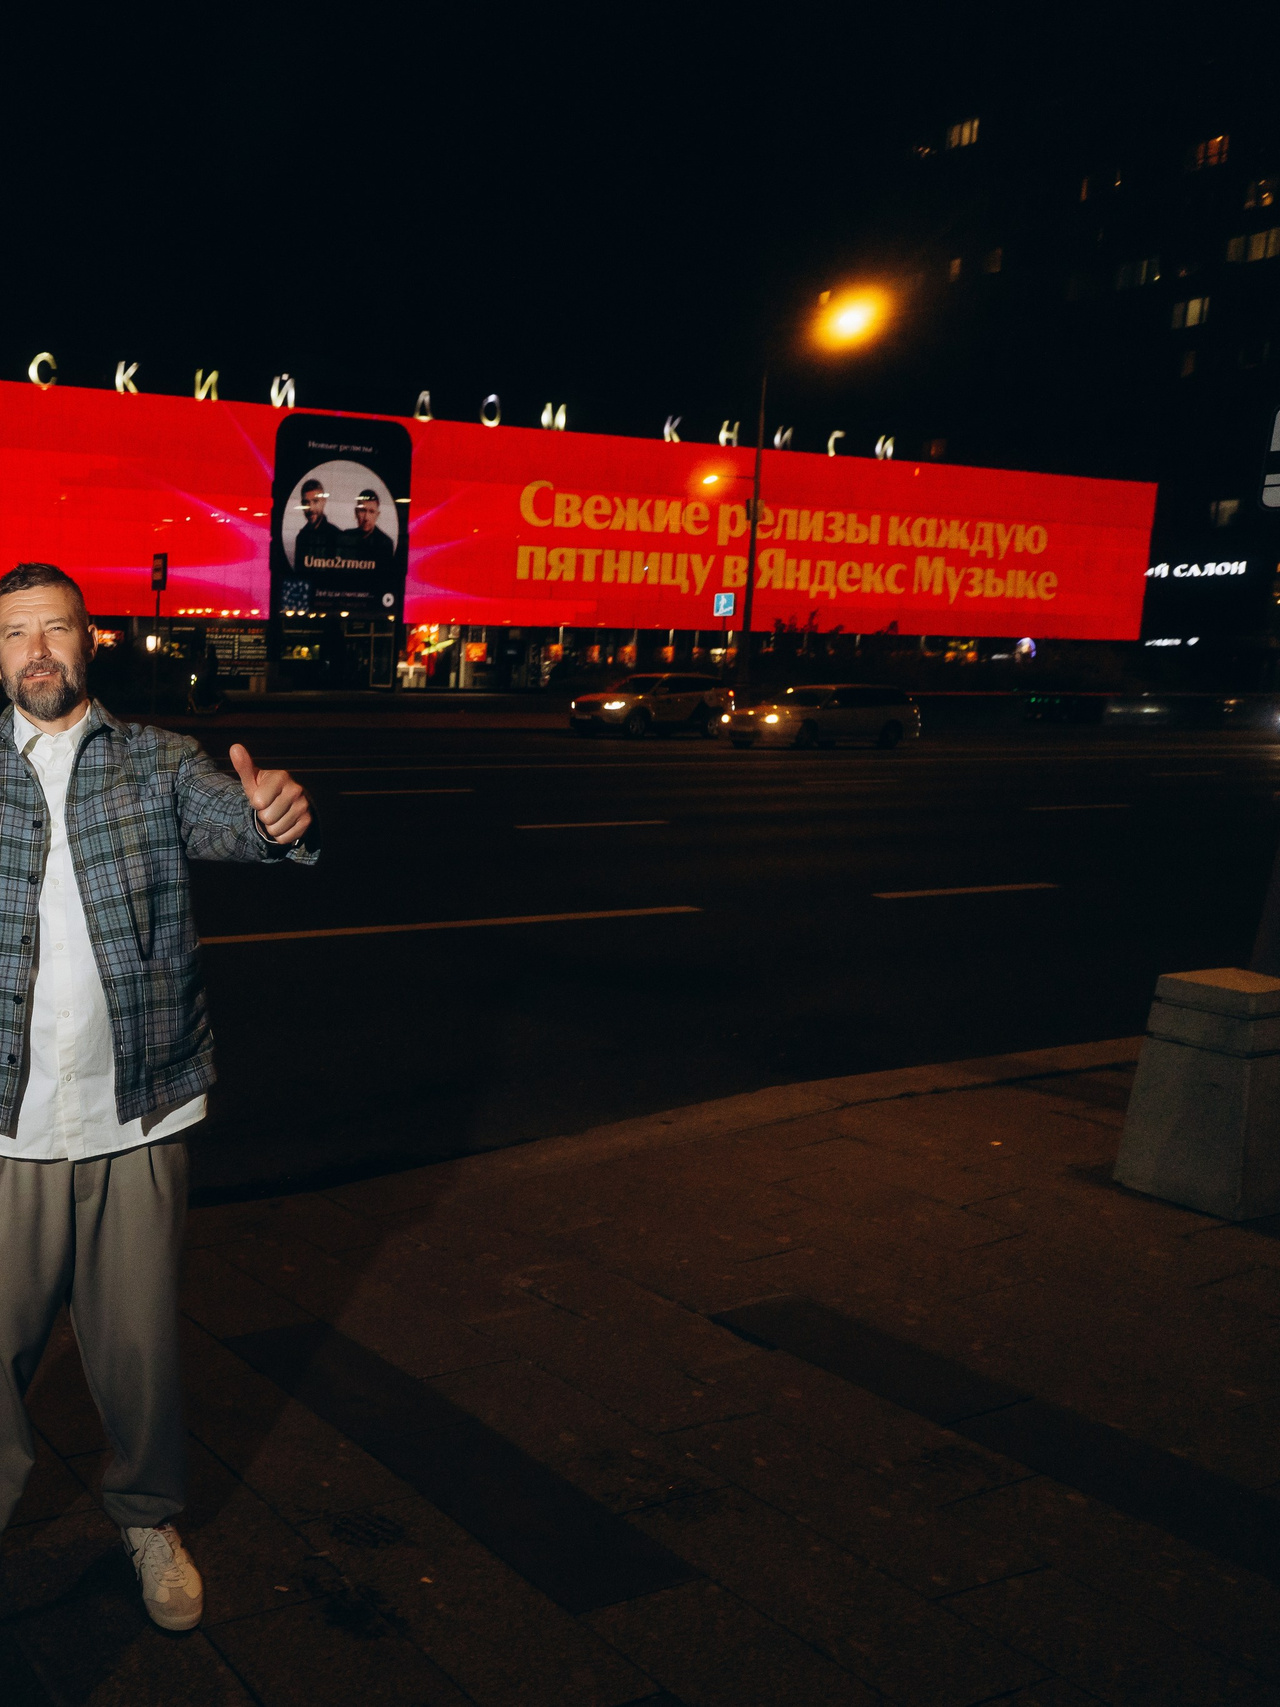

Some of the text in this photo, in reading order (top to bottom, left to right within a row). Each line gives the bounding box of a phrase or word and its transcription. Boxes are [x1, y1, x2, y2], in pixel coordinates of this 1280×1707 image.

[414, 390, 567, 431] ДОМ
[663, 415, 895, 459] КНИГИ
[520, 480, 1049, 561] Свежие релизы каждую
[304, 555, 376, 571] Uma2rman
[516, 544, 1058, 605] пятницу в Яндекс Музыке
[1172, 560, 1248, 578] САЛОН
